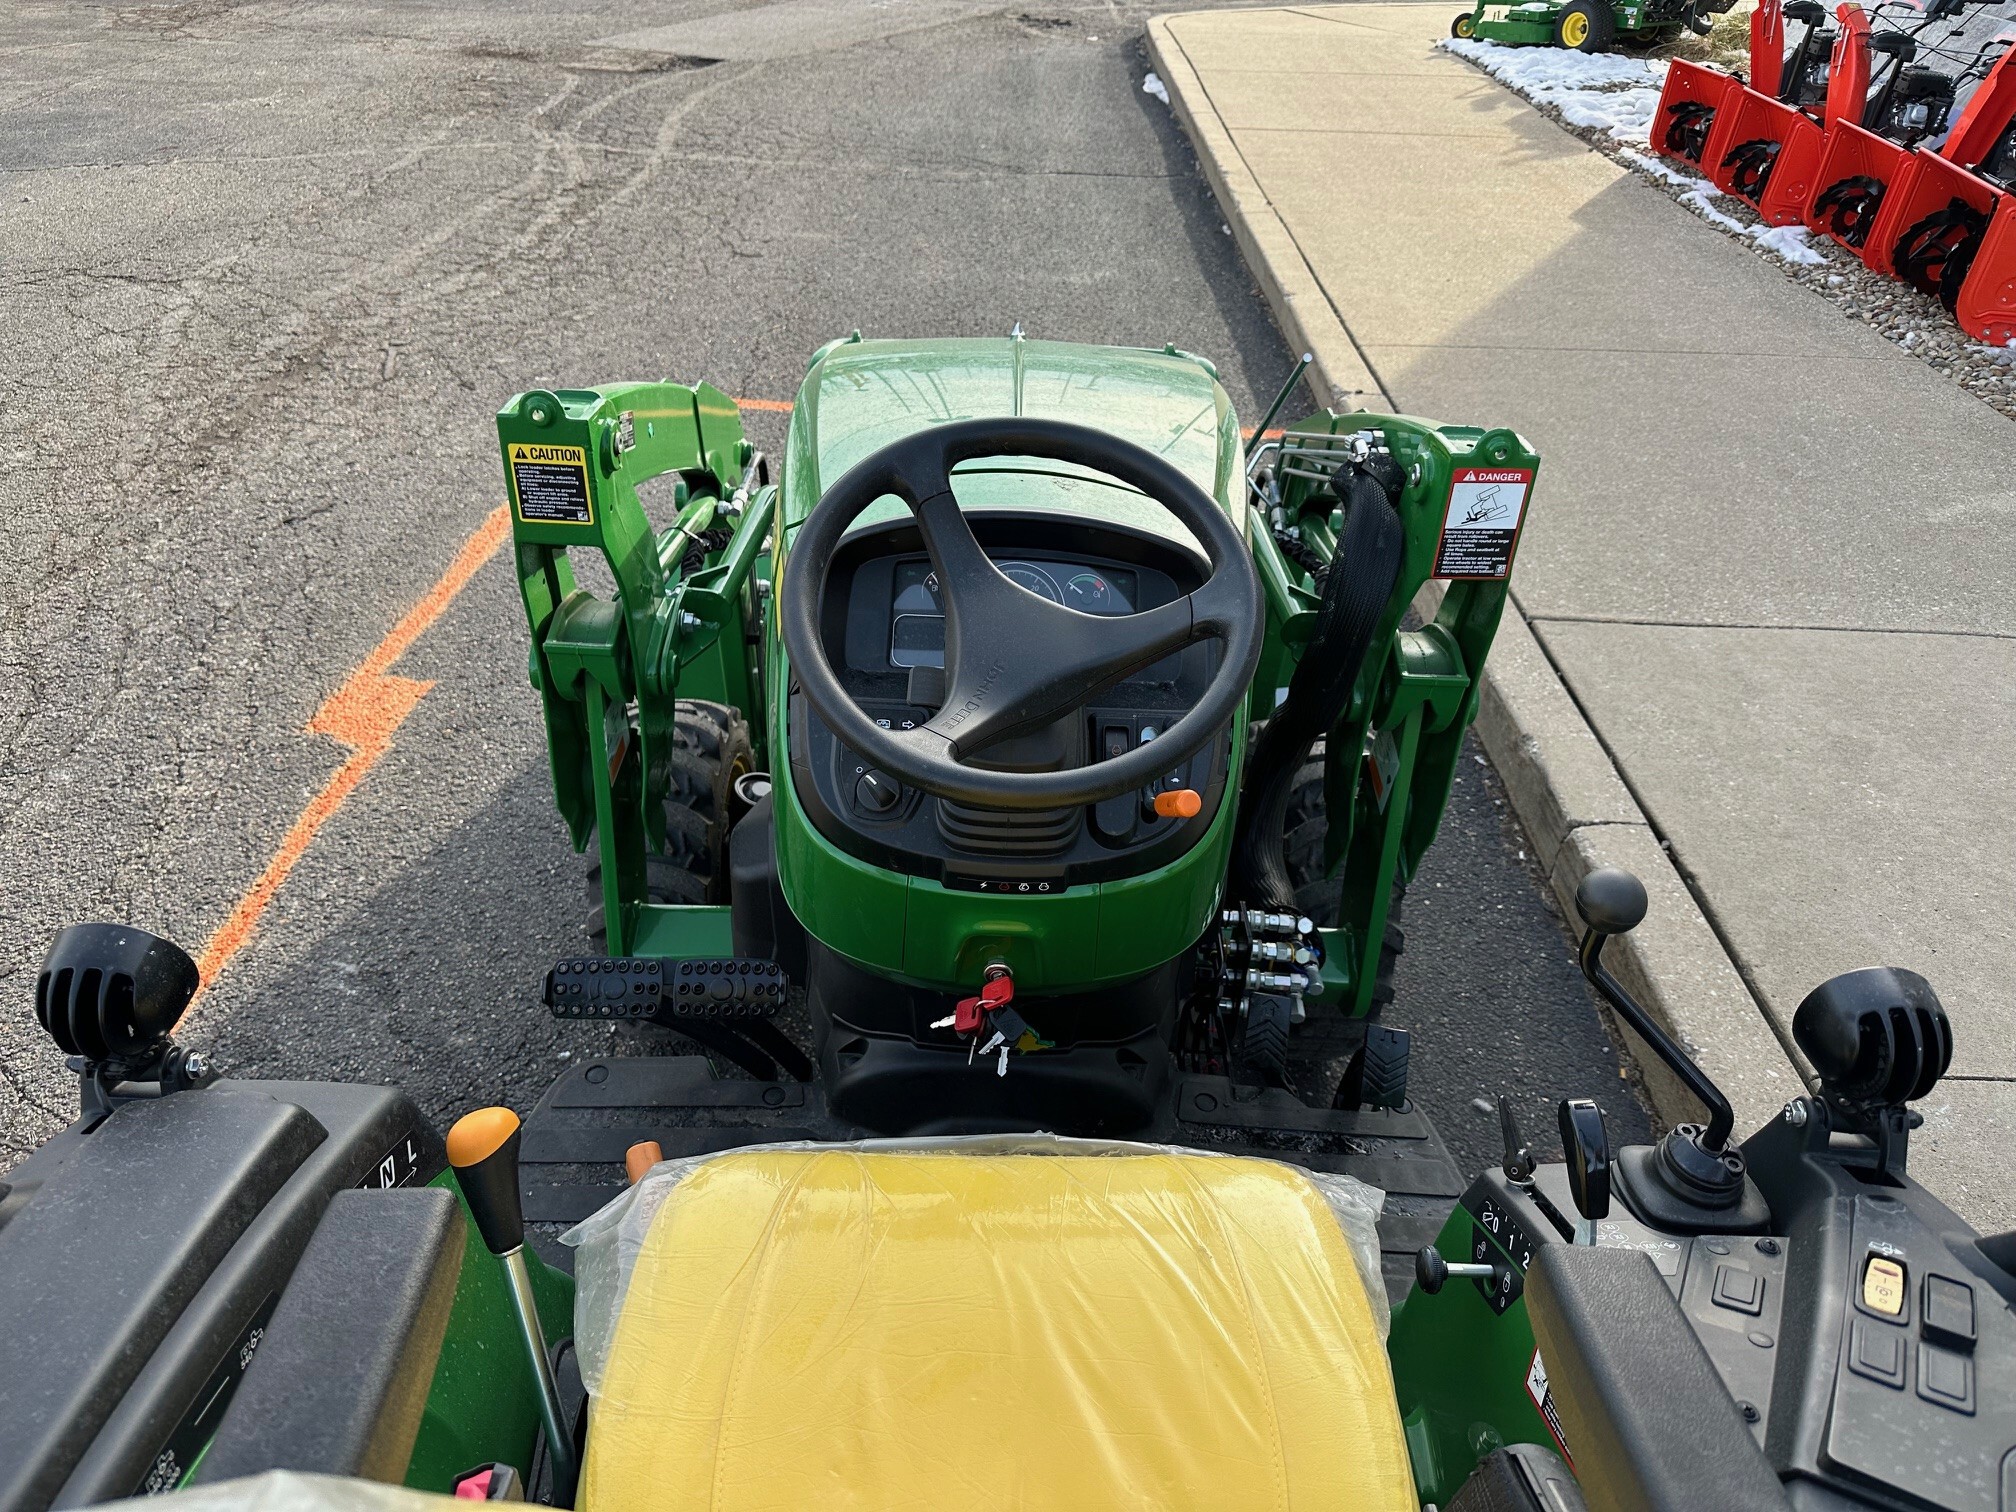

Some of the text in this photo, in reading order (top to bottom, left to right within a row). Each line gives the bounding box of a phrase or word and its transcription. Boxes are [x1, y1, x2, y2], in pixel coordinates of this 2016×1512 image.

[530, 448, 581, 462] CAUTION
[1478, 472, 1521, 481] DANGER
[941, 701, 980, 730] DEERE
[406, 1140, 417, 1164] L
[1492, 1216, 1499, 1233] 0
[1509, 1234, 1514, 1250] 1
[1522, 1251, 1530, 1270] 2
